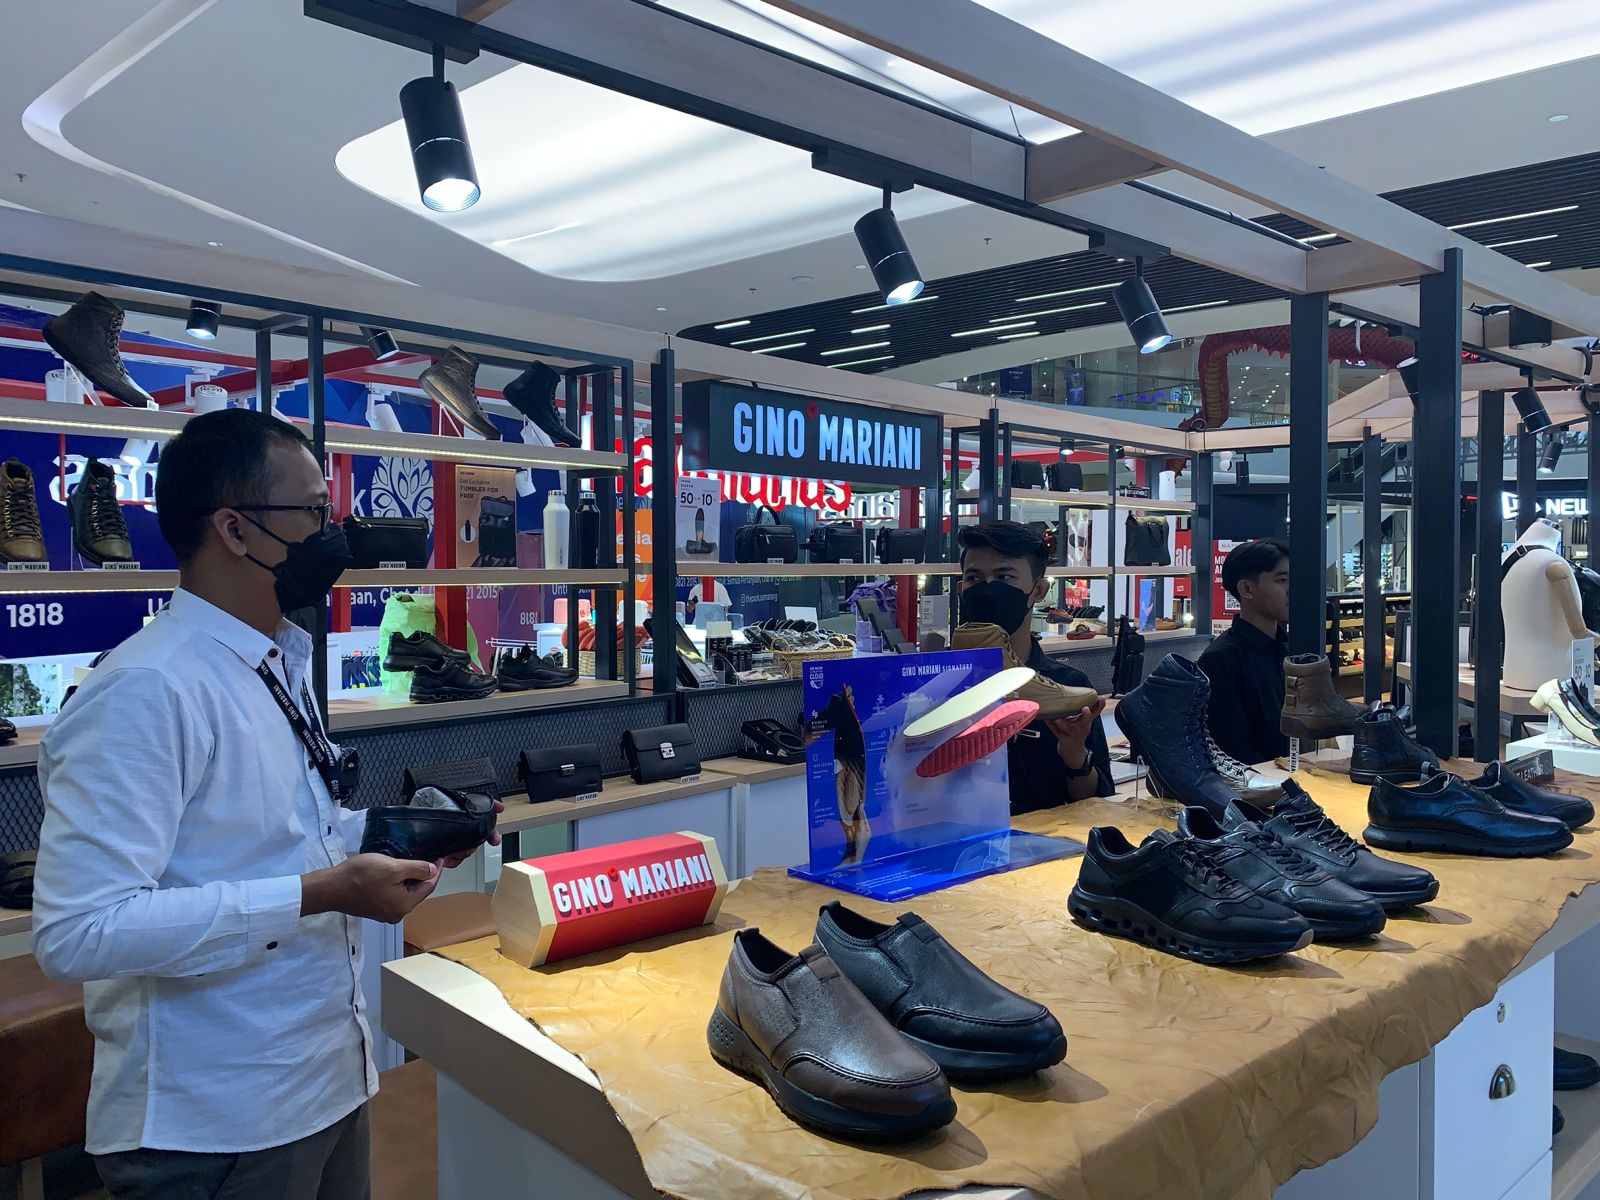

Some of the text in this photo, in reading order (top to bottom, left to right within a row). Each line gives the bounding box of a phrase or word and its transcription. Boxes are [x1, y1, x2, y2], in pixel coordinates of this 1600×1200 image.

[733, 401, 921, 471] GINO MARIANI
[476, 586, 498, 598] 2015
[6, 602, 64, 628] 1818
[902, 663, 972, 677] GINO MARIANI SIGNATURE
[552, 853, 713, 914] GINO MARIANI
